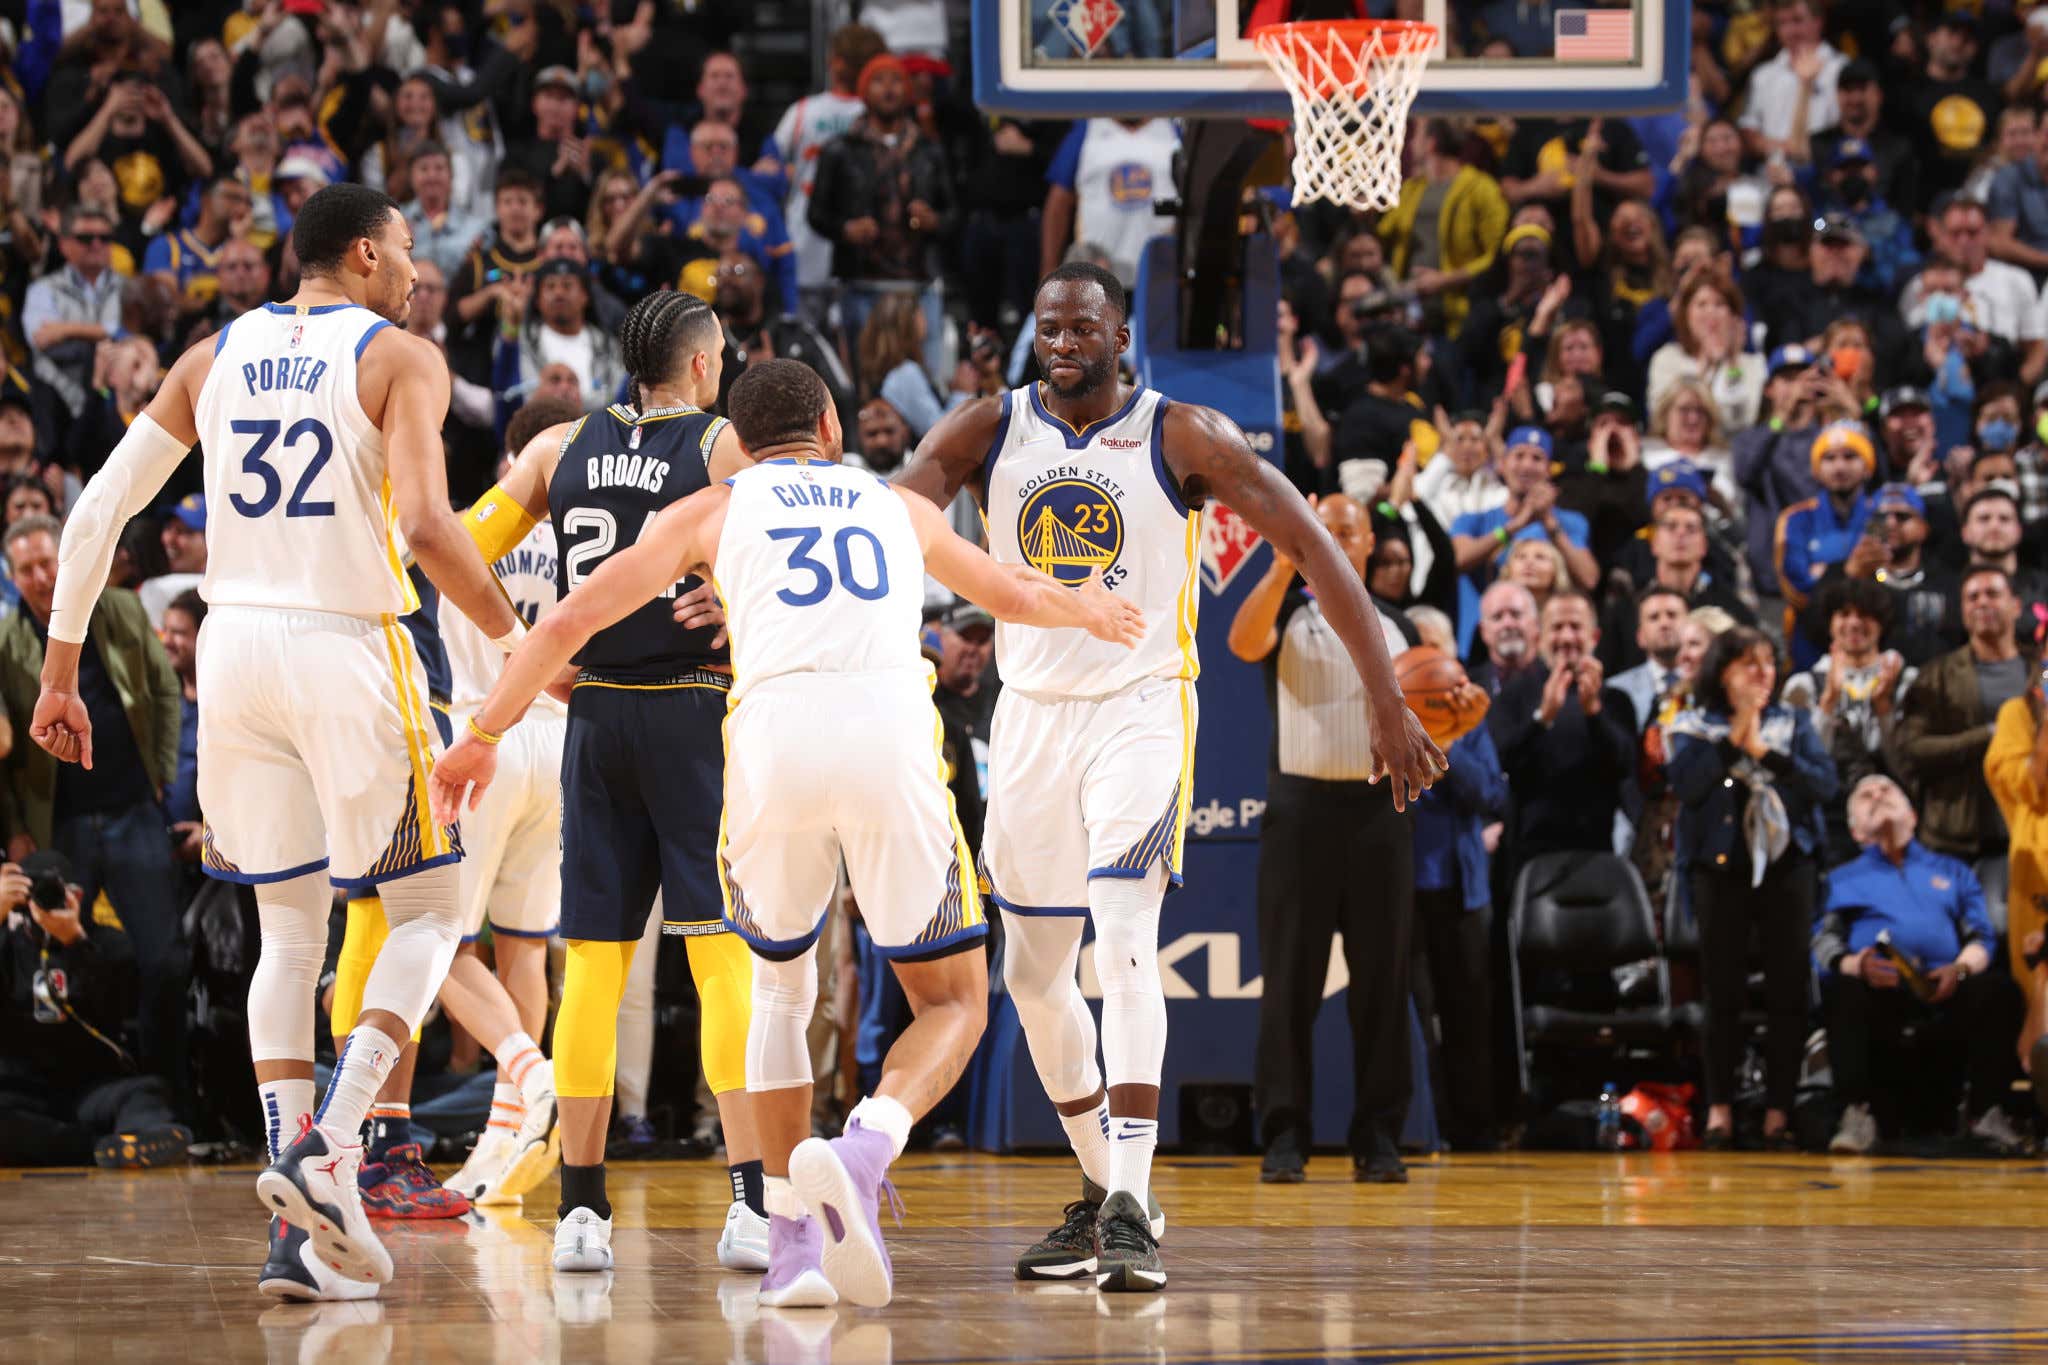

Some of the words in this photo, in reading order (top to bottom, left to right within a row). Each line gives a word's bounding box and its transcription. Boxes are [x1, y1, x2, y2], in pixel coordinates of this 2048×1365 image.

[242, 356, 328, 397] PORTER
[1100, 437, 1142, 449] Rakuten
[229, 418, 335, 518] 32
[587, 454, 671, 494] BROOKS
[1018, 466, 1078, 499] GOLDEN
[1085, 469, 1125, 501] STATE
[771, 484, 862, 510] CURRY
[1074, 503, 1110, 534] 23
[494, 550, 559, 586] HOMPS
[765, 526, 889, 606] 30
